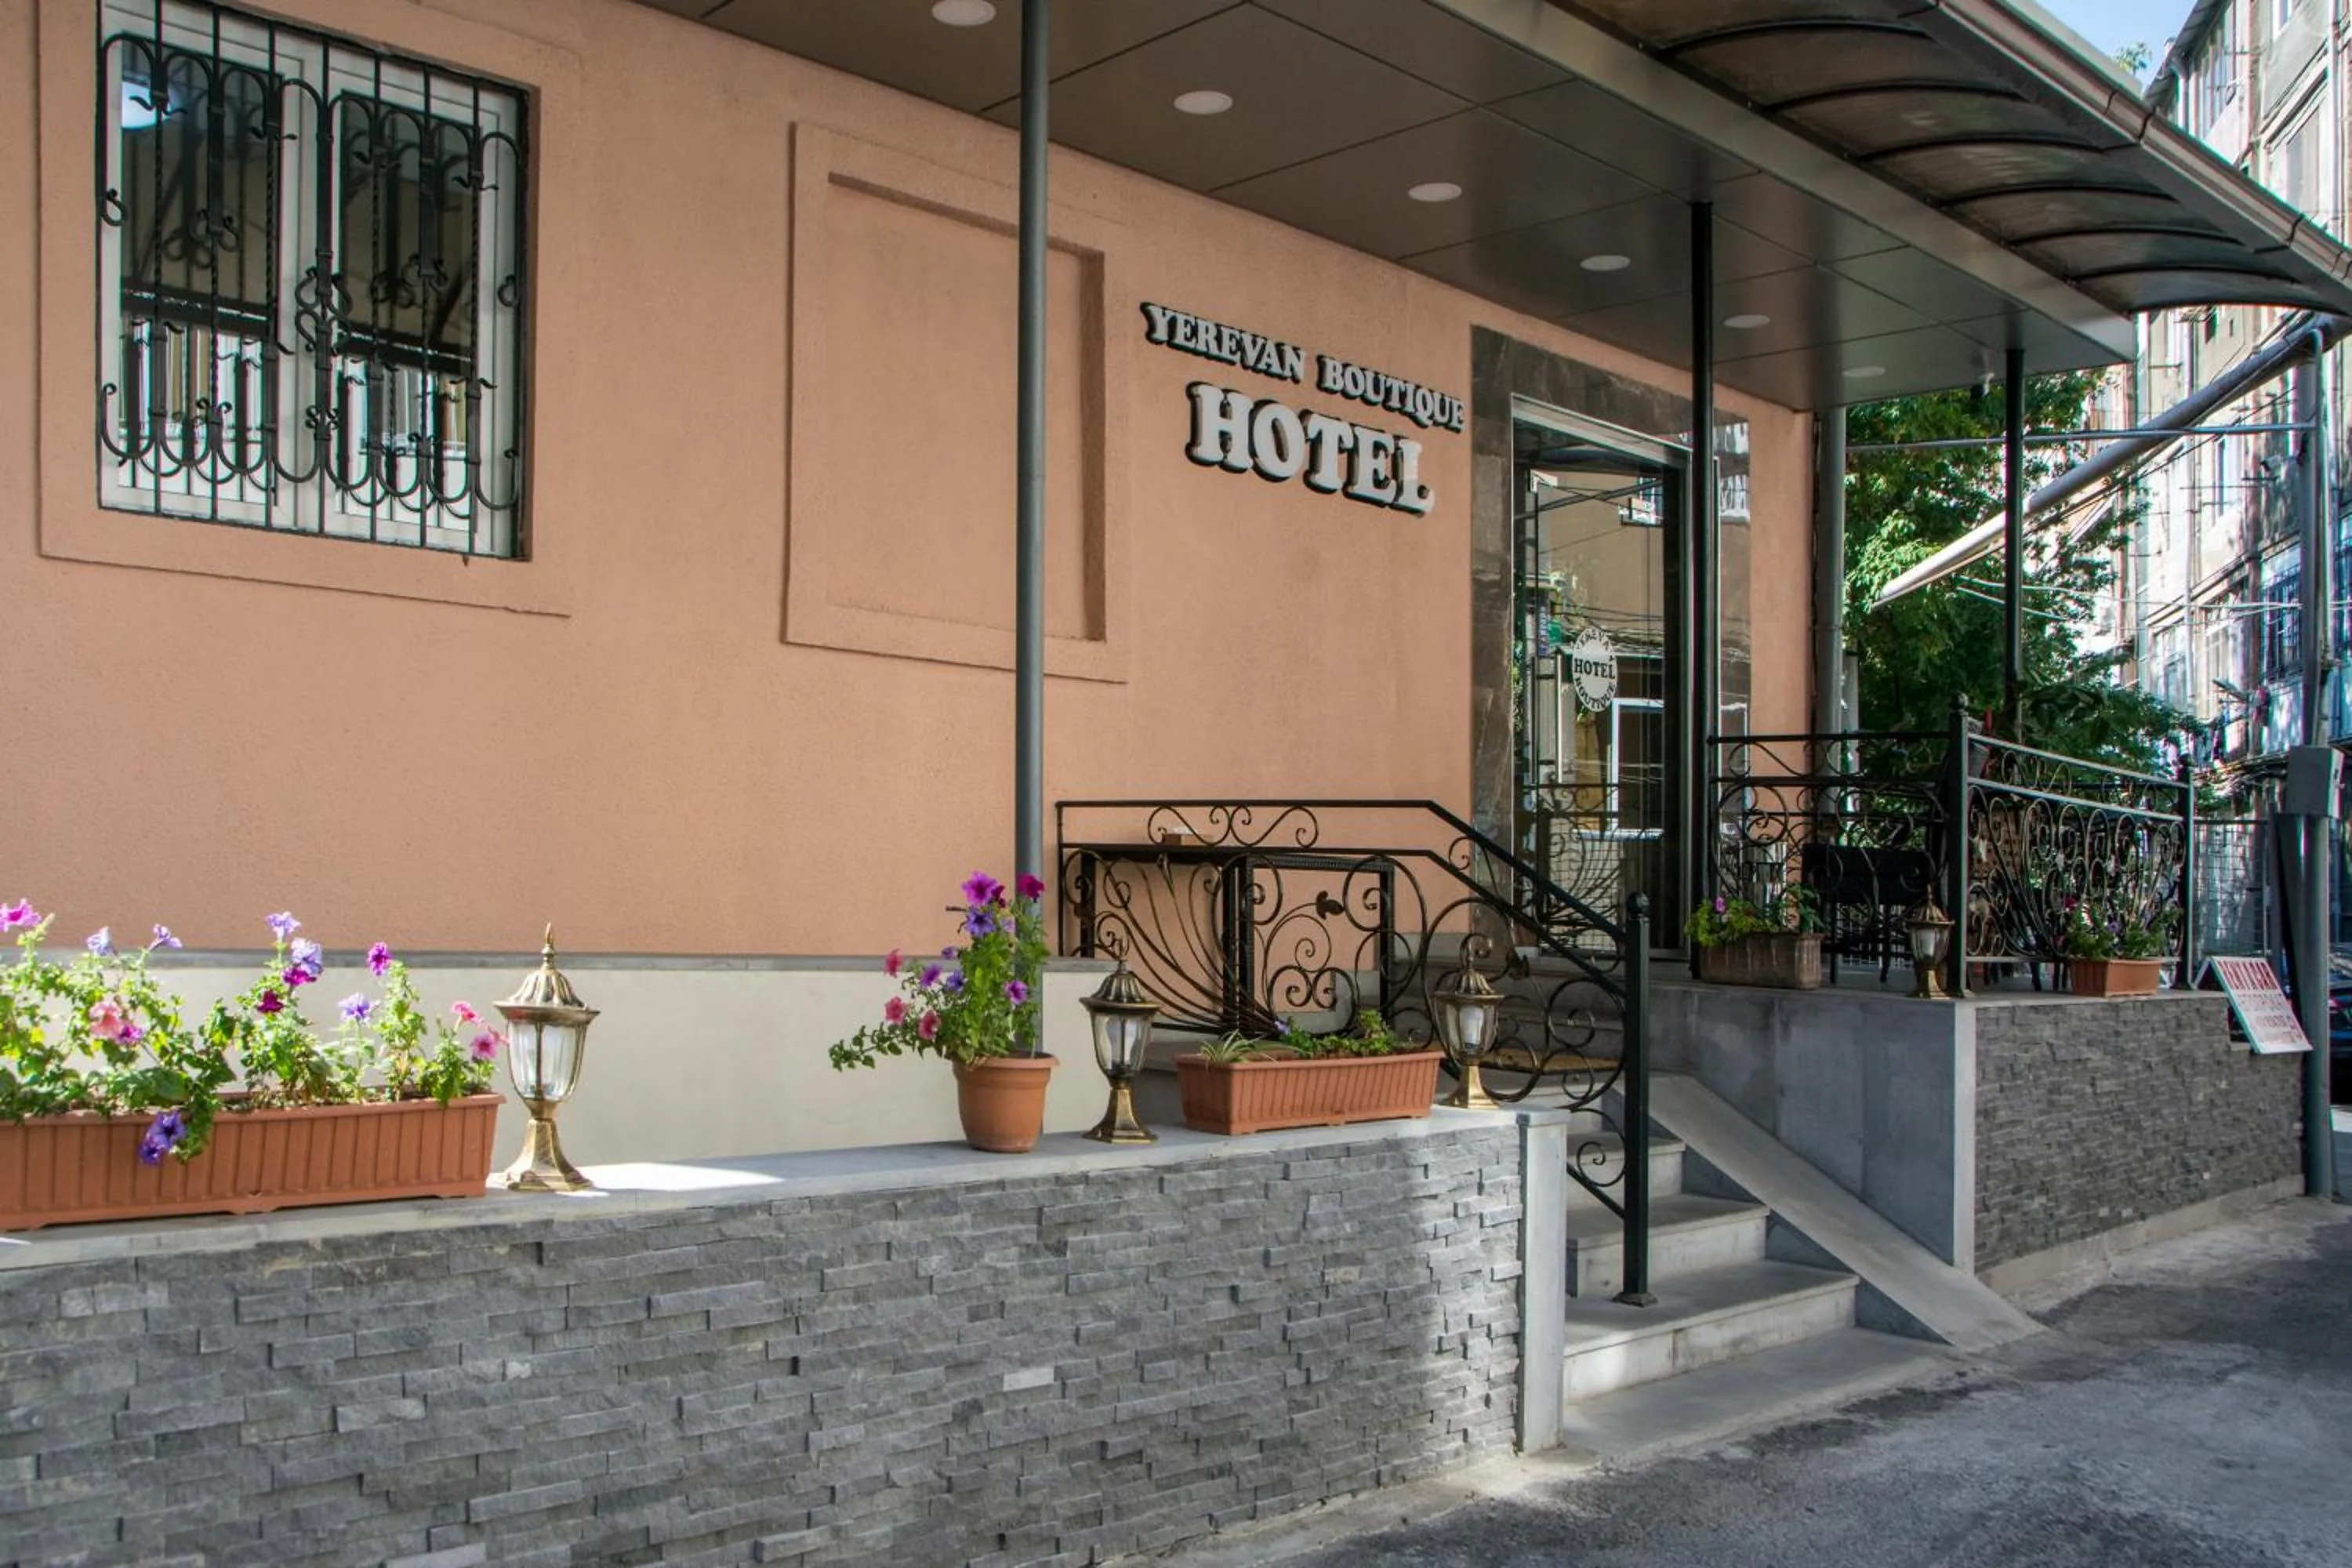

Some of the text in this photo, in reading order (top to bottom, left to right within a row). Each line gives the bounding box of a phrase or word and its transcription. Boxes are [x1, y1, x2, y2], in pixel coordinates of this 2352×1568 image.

[1142, 303, 1465, 432] YEREVAN BOUTIQUE
[1185, 382, 1435, 516] HOTEL
[1574, 658, 1615, 680] HOTEL
